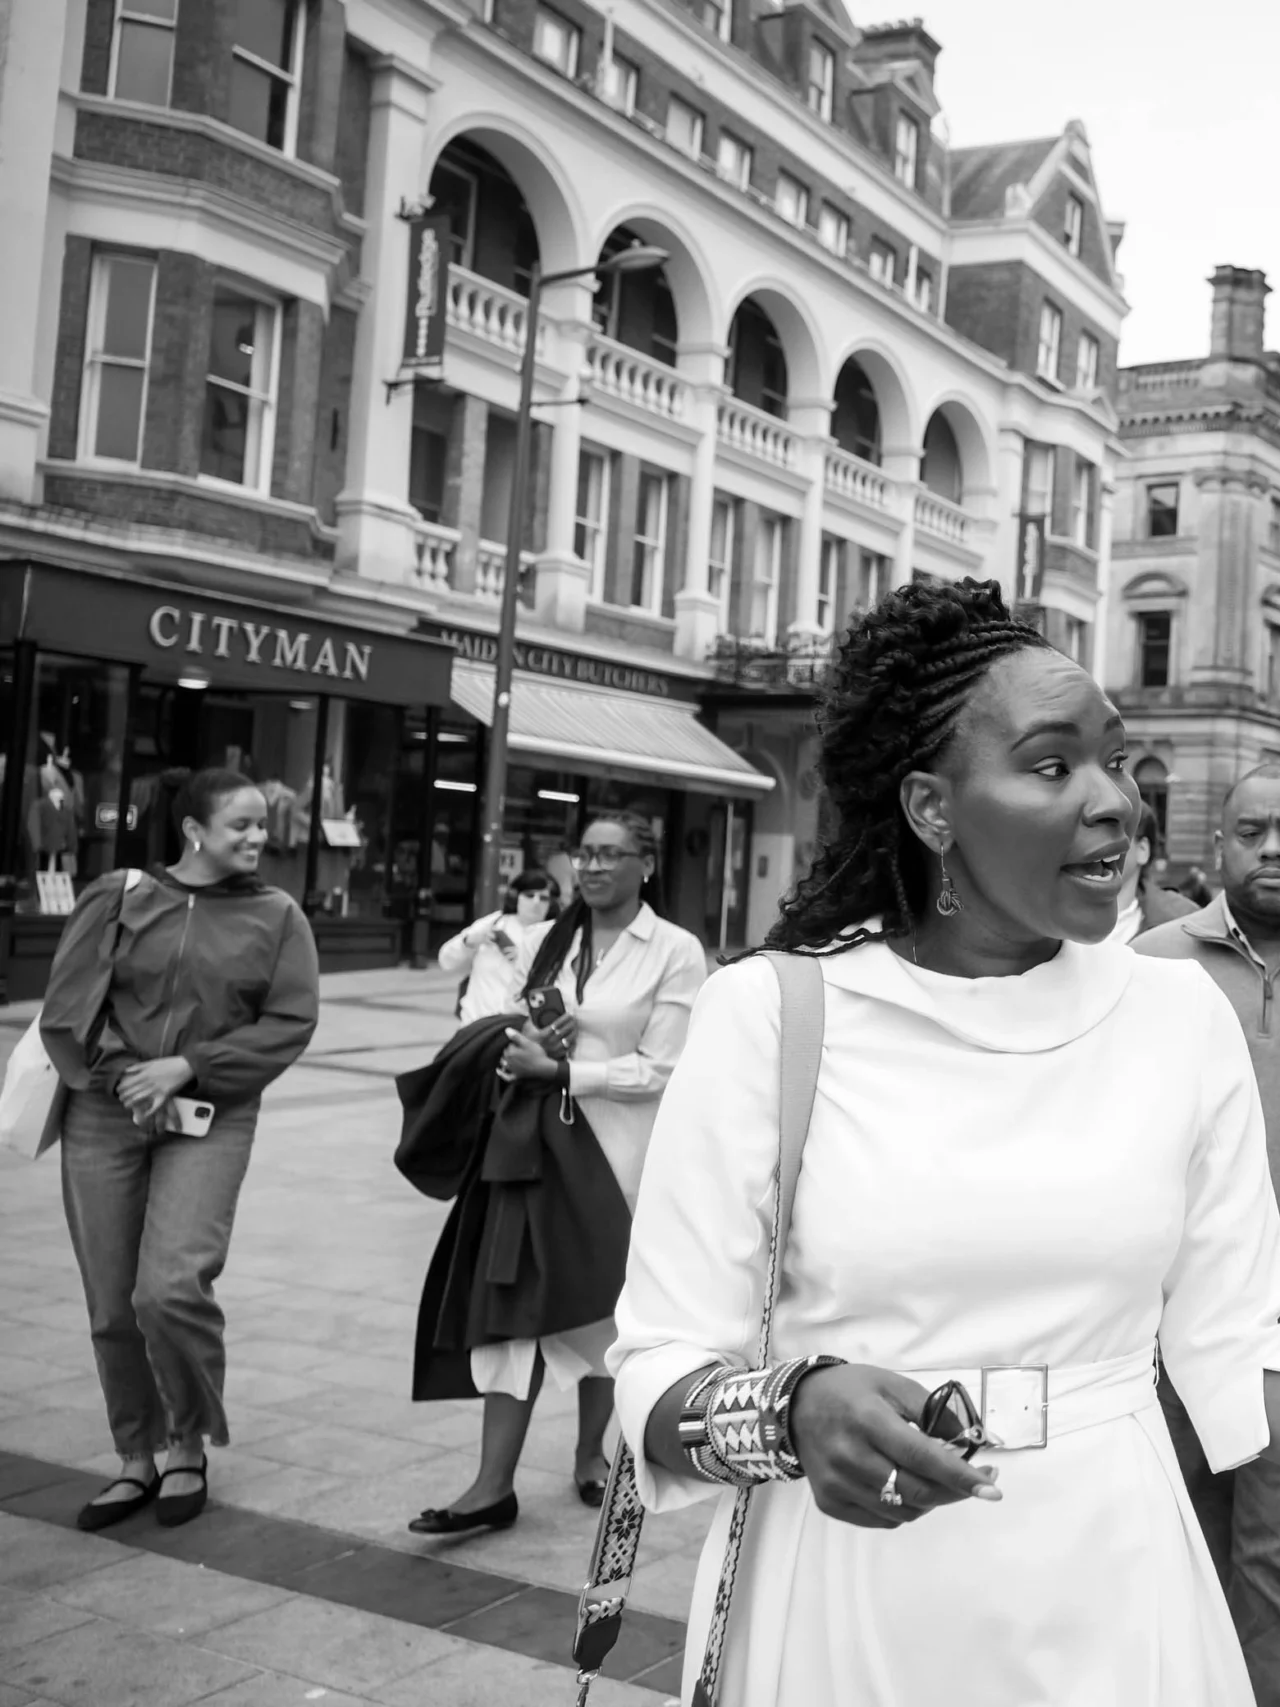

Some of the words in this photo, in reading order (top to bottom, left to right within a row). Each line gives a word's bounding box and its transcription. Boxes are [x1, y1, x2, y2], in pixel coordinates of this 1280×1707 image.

[150, 605, 372, 681] CITYMAN
[440, 629, 526, 667] MAIDN
[527, 649, 577, 676] CITY
[577, 658, 668, 697] BUTCHERS
